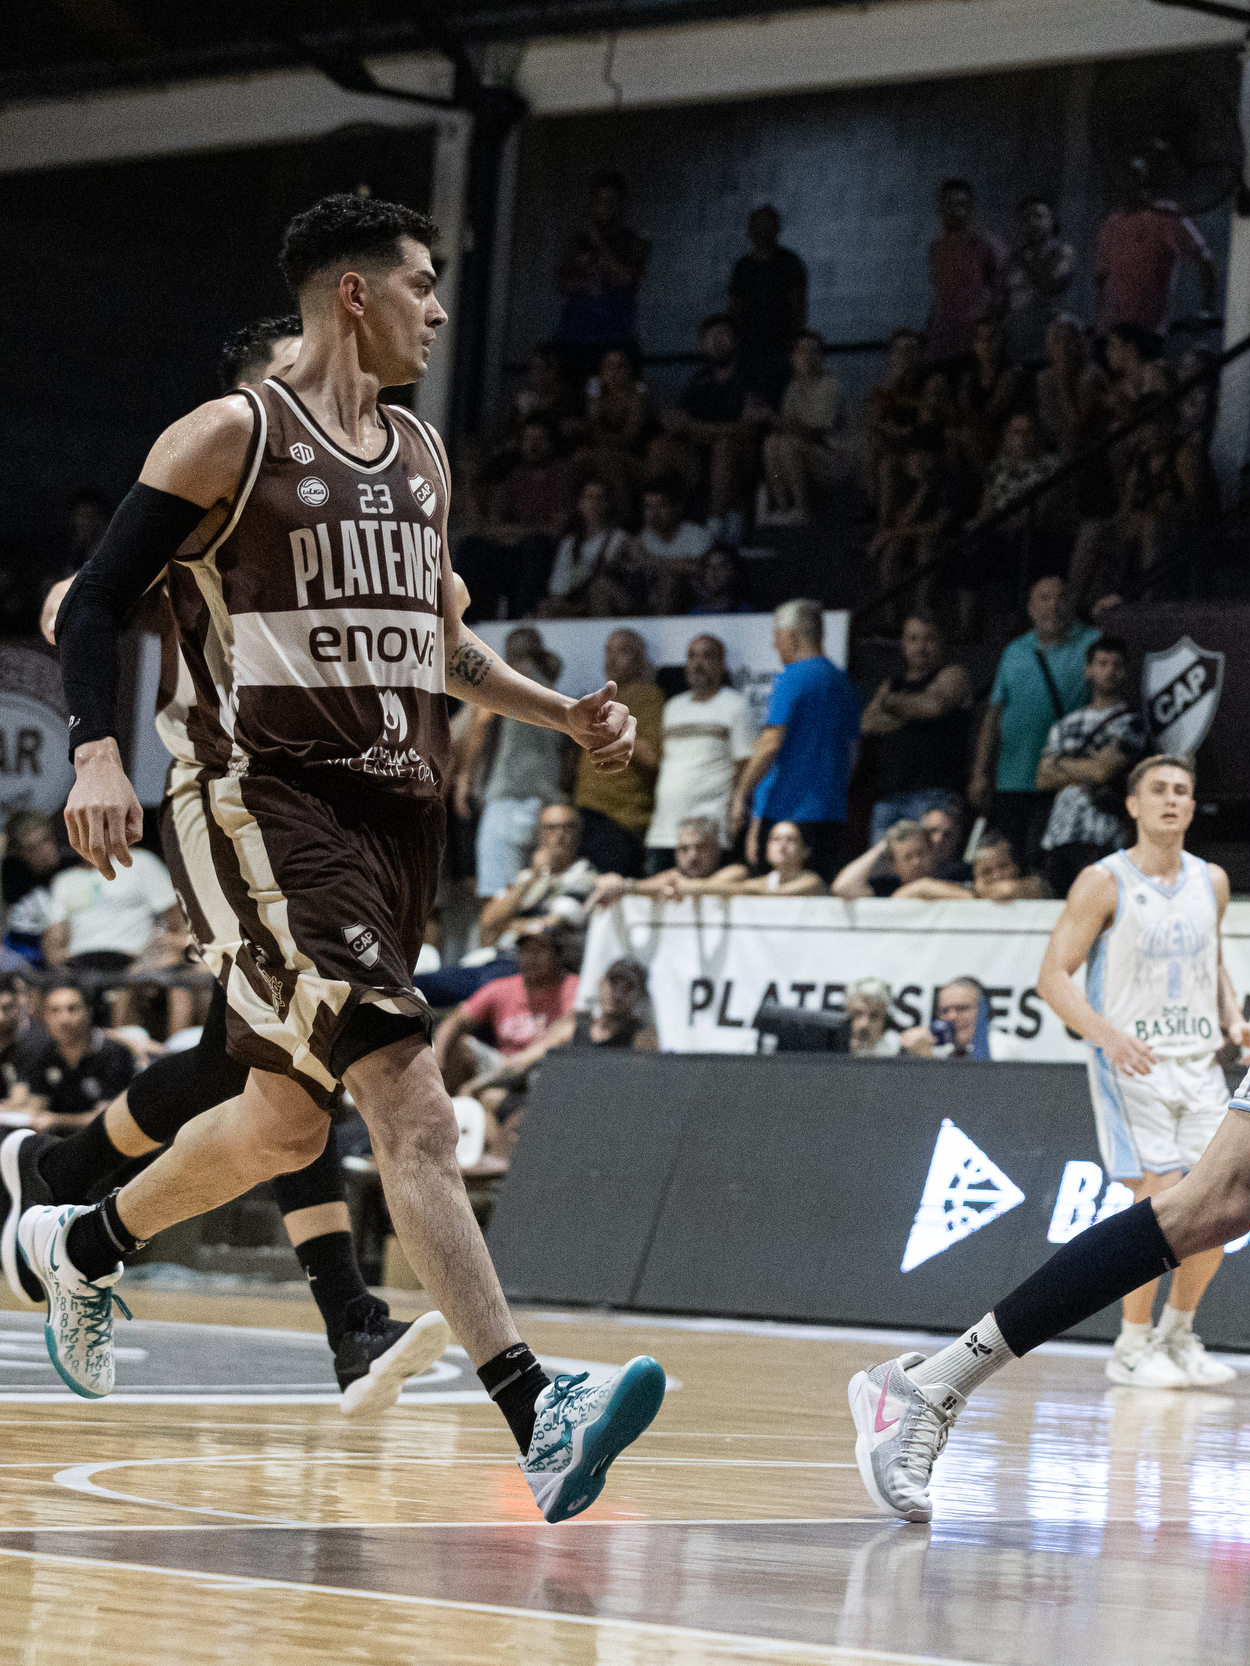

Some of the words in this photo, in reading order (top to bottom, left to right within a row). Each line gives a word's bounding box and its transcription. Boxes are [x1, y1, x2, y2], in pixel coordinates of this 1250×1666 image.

[357, 483, 395, 515] 23
[416, 483, 432, 503] CAP
[289, 520, 442, 609] PLATENS
[1153, 663, 1207, 724] CAP
[352, 931, 374, 954] CAP
[1135, 1016, 1213, 1042] BASILIO
